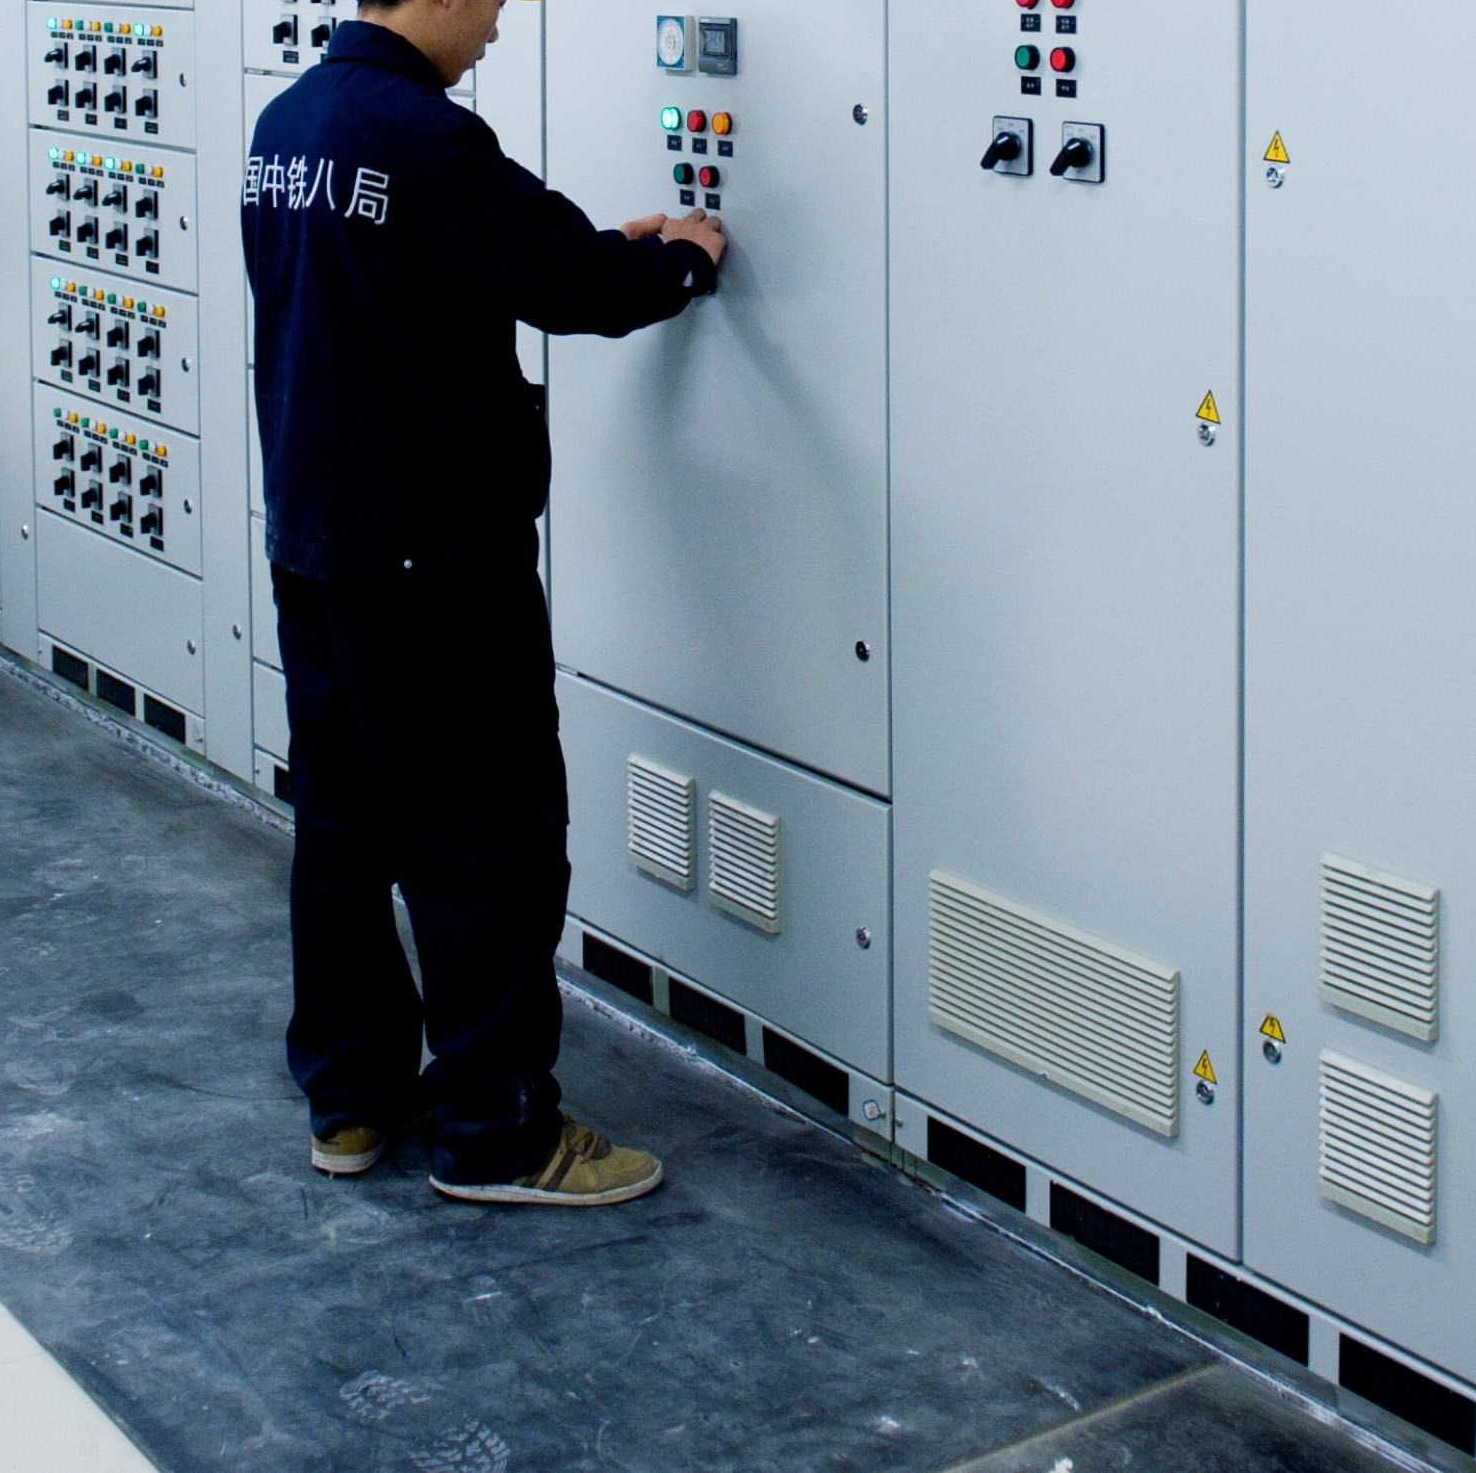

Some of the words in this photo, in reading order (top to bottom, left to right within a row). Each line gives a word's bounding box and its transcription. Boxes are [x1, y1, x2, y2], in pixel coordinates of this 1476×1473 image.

[242, 153, 390, 225] 国中铁八局
